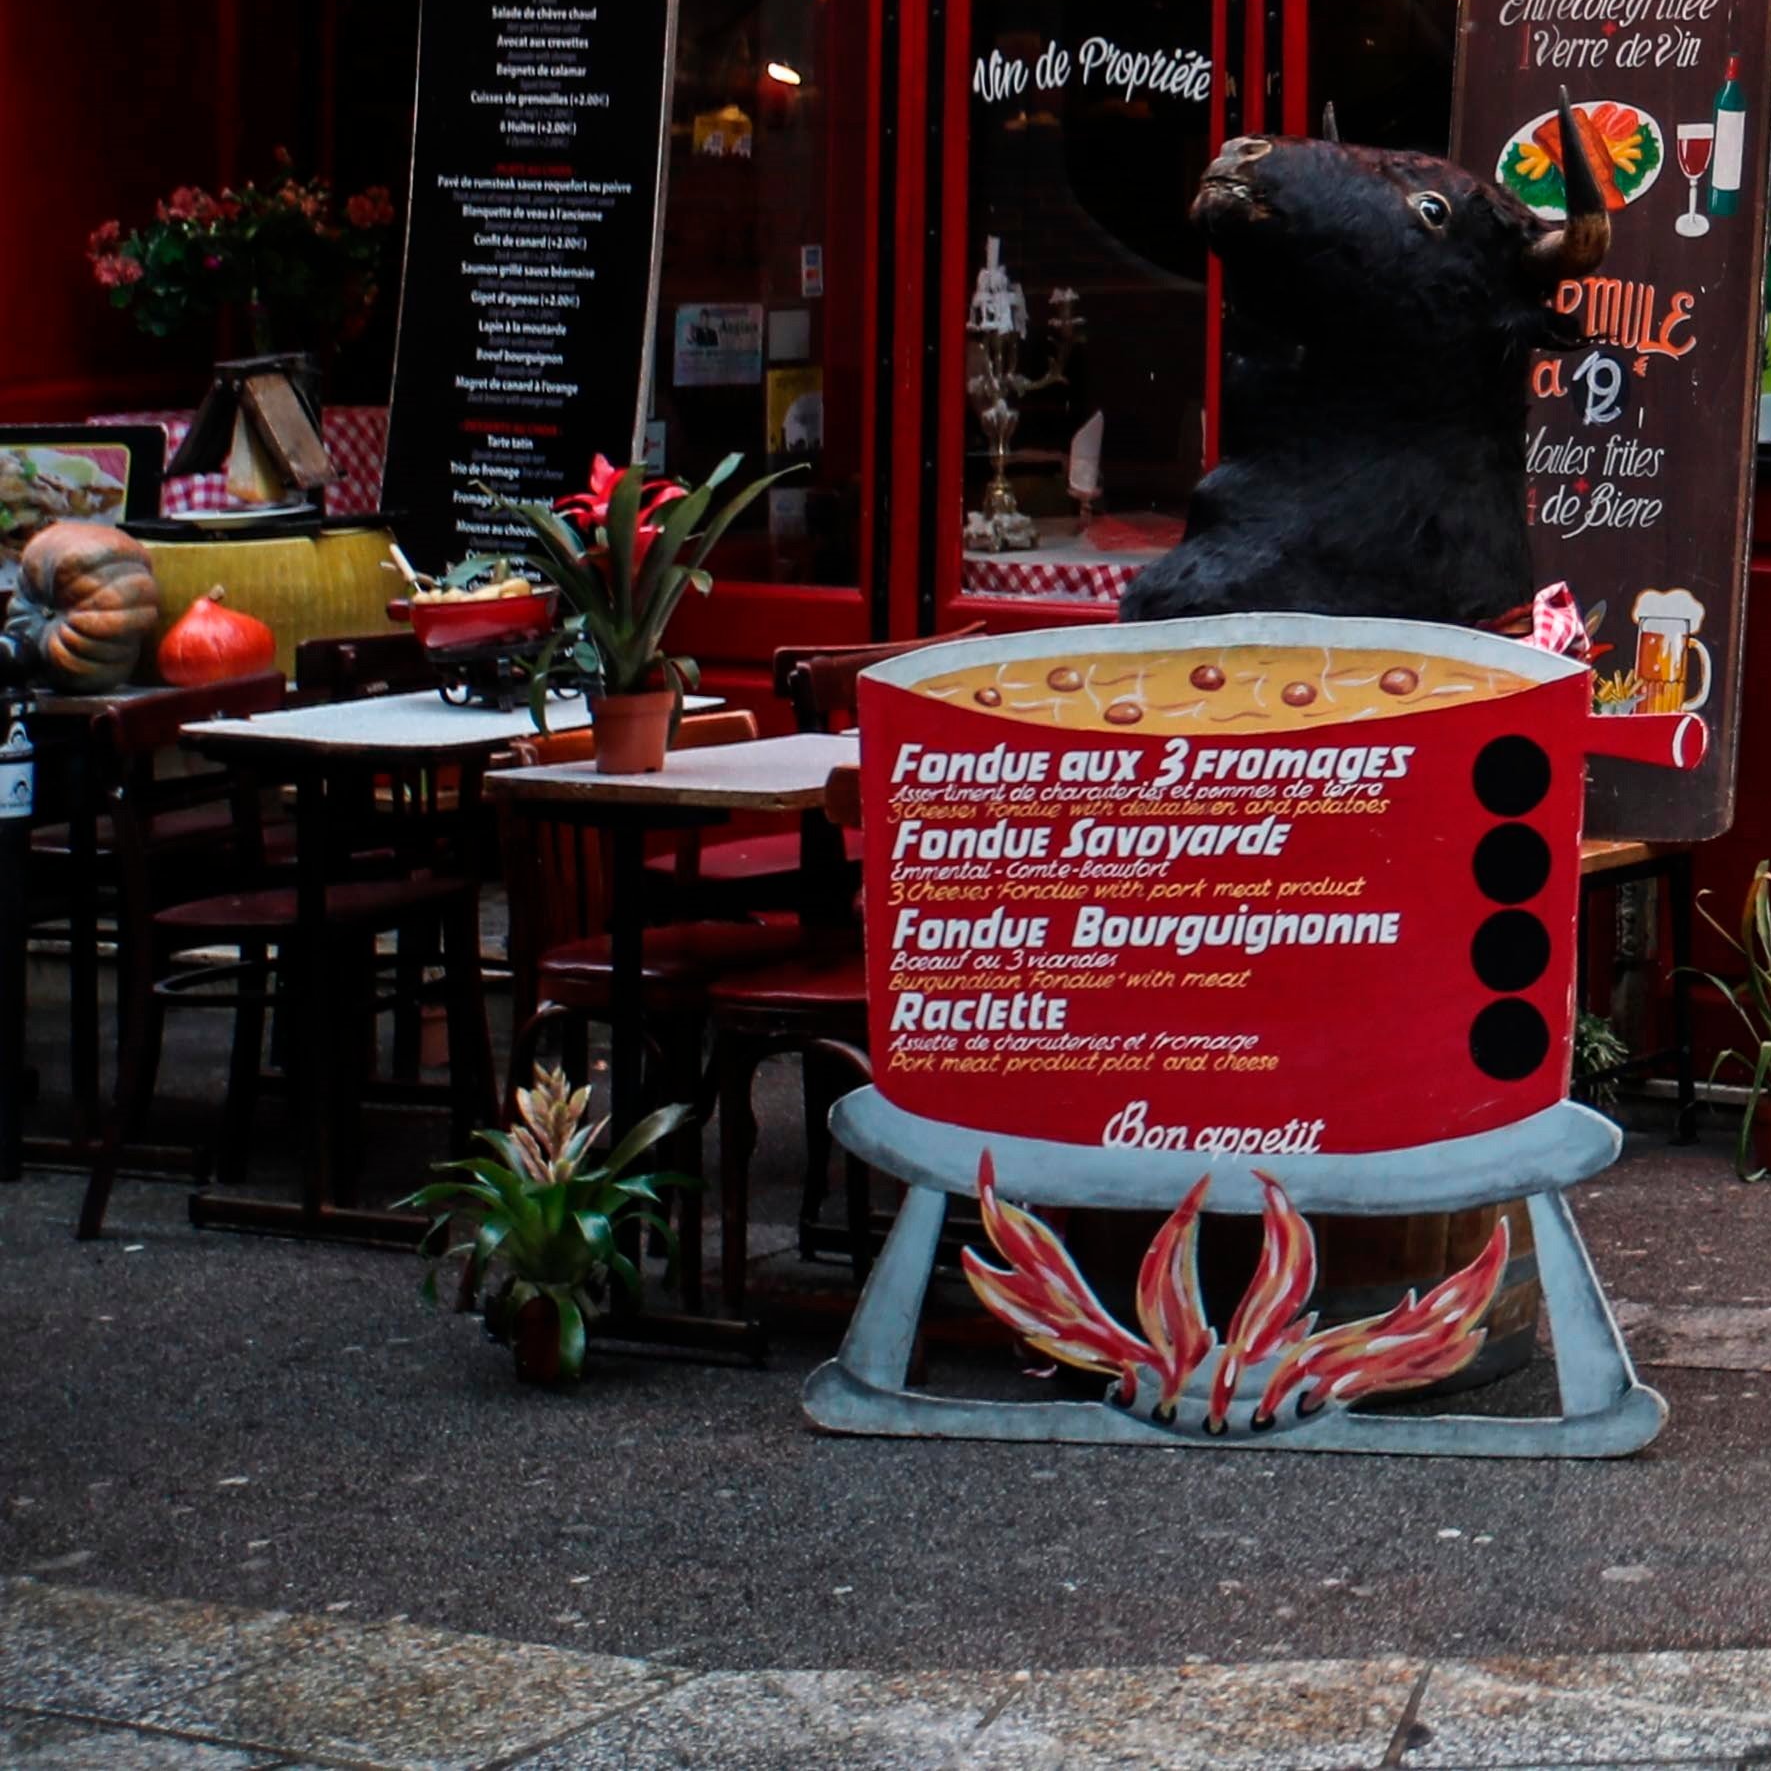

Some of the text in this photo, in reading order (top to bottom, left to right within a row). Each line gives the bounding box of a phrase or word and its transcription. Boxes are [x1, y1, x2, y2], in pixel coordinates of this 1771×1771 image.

[1035, 40, 1071, 91] de
[1615, 30, 1651, 68] de
[1602, 434, 1665, 478] frites
[1541, 483, 1581, 526] de
[1058, 749, 1143, 783] aux
[1152, 737, 1190, 787] 3
[1060, 817, 1293, 862] Savoyarde
[1071, 905, 1401, 955] Bourguignonne
[1213, 1051, 1280, 1073] cheese
[1102, 1099, 1189, 1152] Bon
